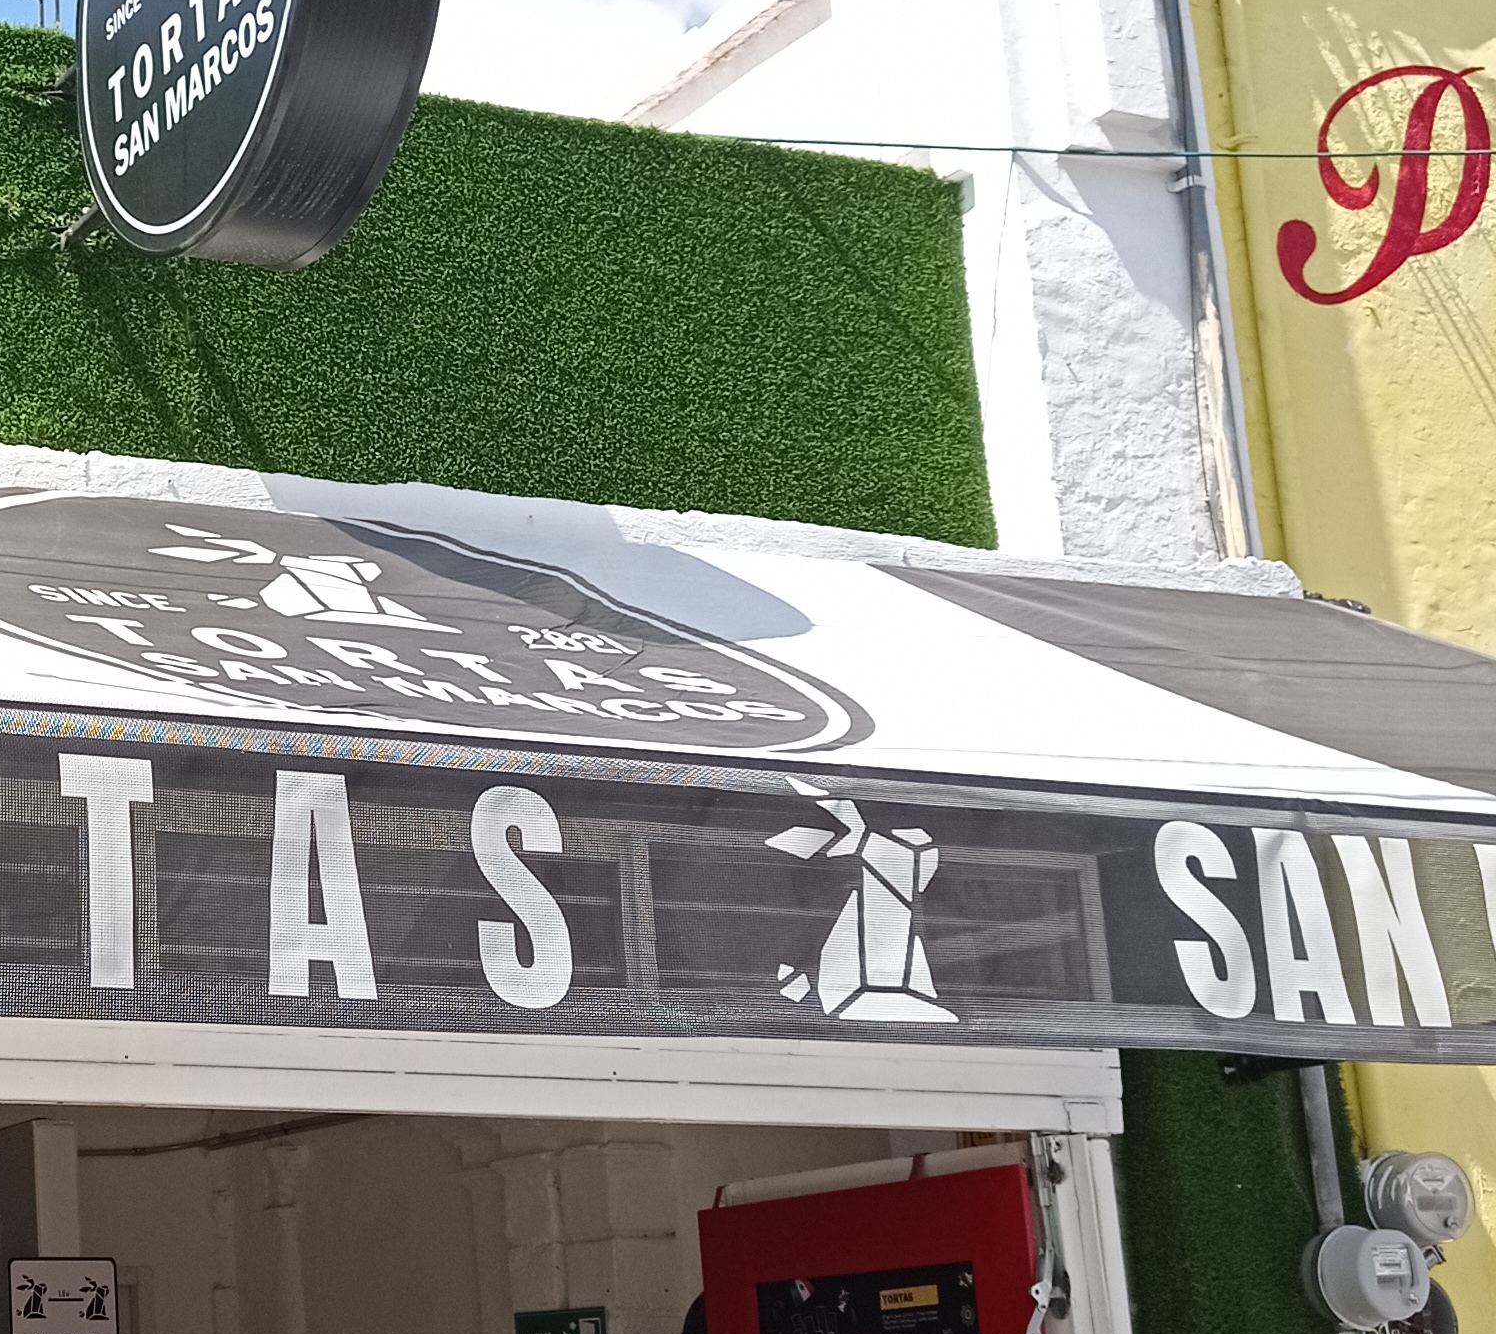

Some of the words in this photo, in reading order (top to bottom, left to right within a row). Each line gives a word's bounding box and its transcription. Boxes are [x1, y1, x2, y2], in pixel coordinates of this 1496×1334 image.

[114, 101, 160, 177] SAN
[27, 583, 187, 613] SINCE
[64, 613, 737, 695] TORTAS
[140, 651, 366, 692] SAN
[371, 674, 807, 722] MARCOS
[1153, 819, 1454, 1029] SAN
[882, 1292, 914, 1305] TORTAS
